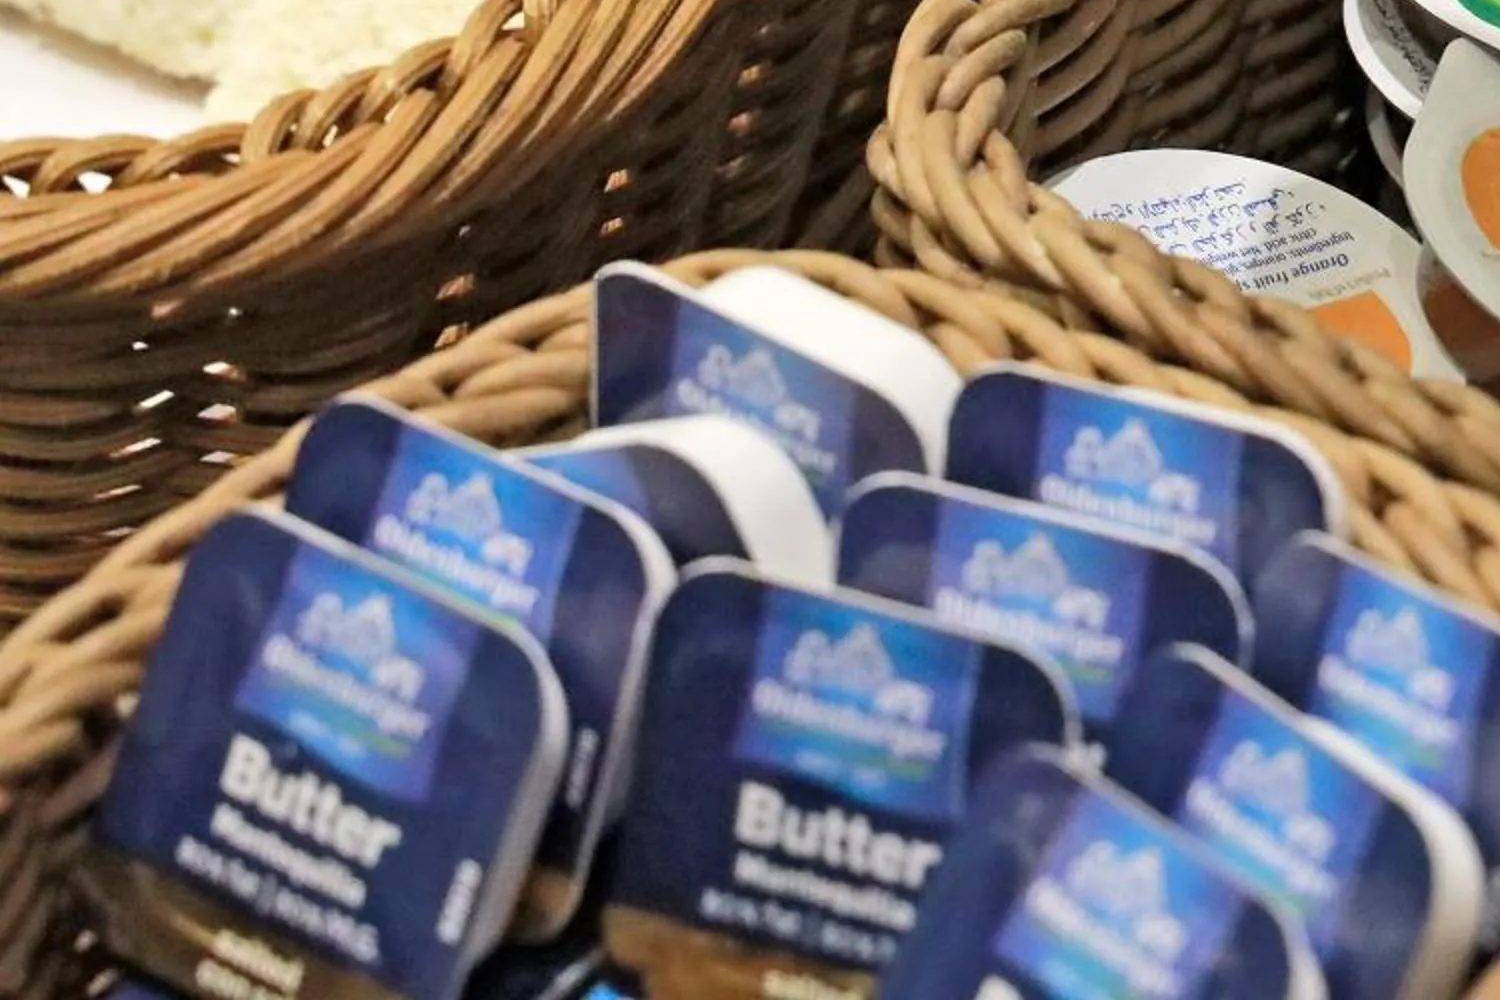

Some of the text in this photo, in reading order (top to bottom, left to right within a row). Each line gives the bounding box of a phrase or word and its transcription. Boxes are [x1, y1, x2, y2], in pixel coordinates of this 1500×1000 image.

[1253, 271, 1289, 289] fruit
[1291, 254, 1349, 278] Orange
[220, 733, 401, 868] Butter
[735, 780, 942, 888] Butter
